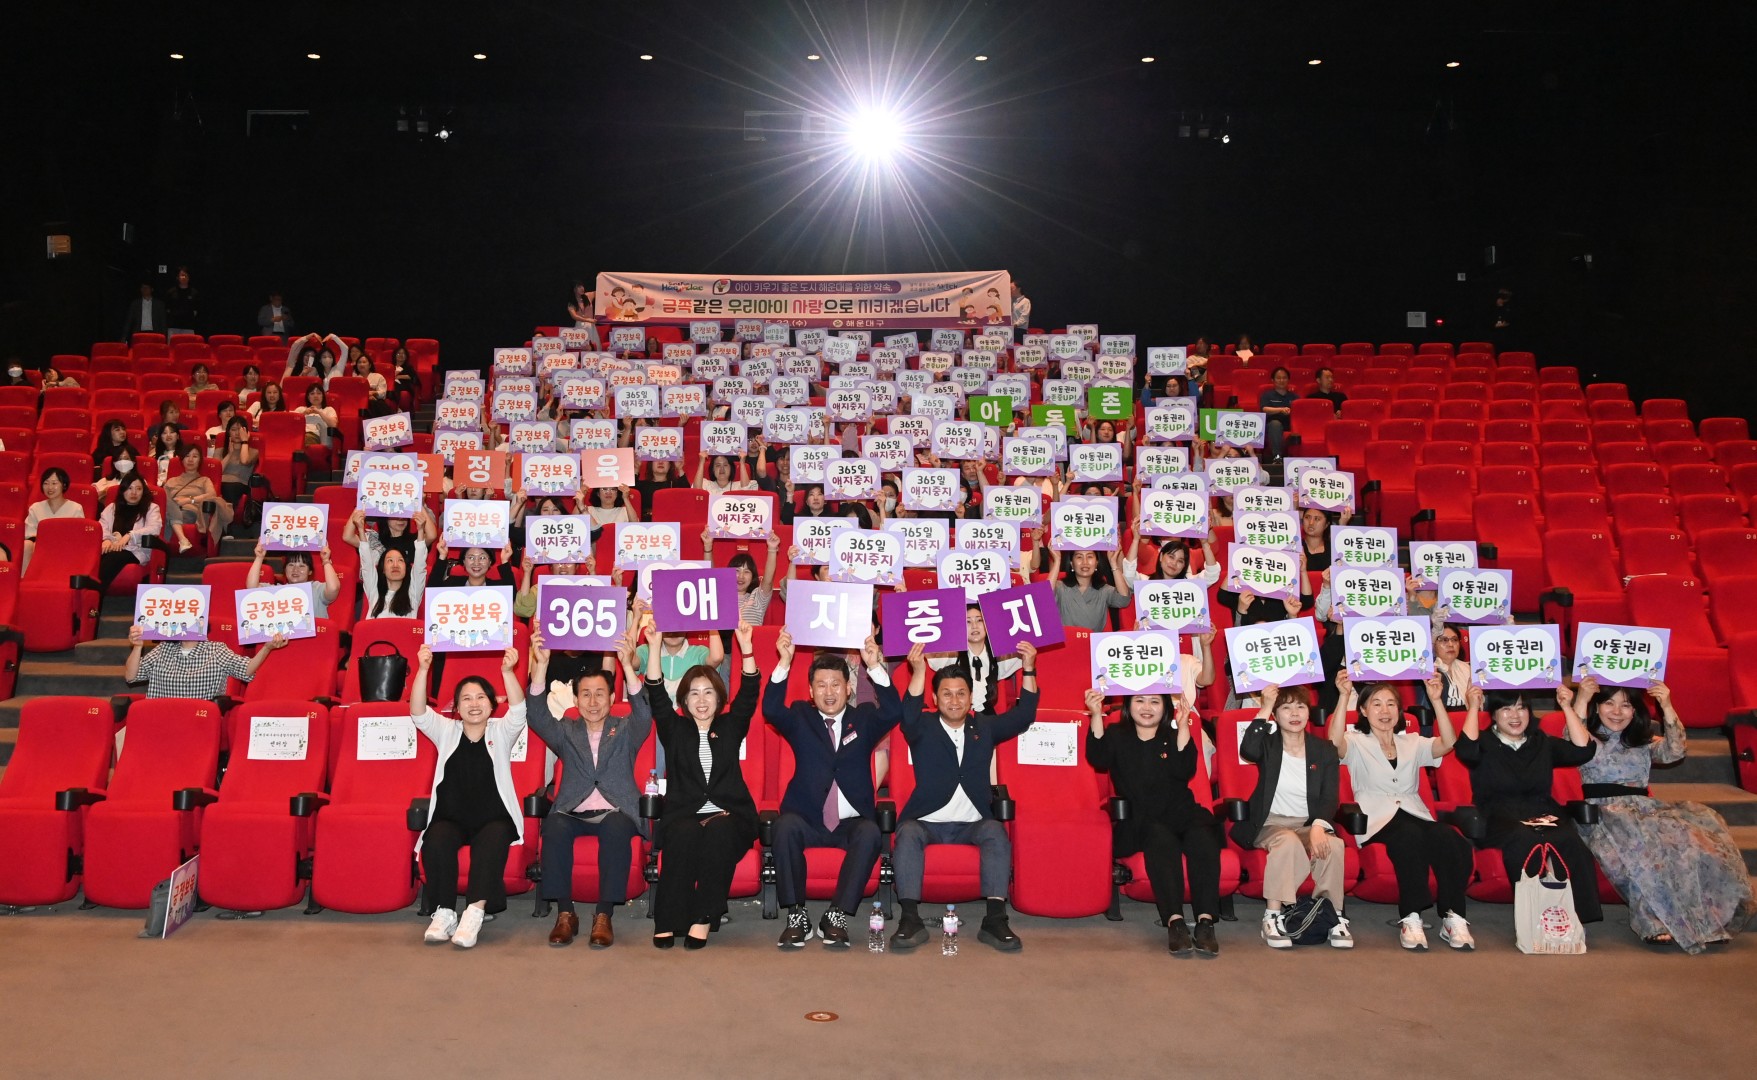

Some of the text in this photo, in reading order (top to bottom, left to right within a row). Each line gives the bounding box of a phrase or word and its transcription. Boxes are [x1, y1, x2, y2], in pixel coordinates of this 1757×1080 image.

[734, 282, 751, 292] 아이
[754, 282, 780, 292] 키우기
[782, 282, 798, 292] 좋은
[800, 282, 817, 292] 도시
[818, 282, 852, 292] 해운대를
[855, 282, 872, 292] 위한
[662, 298, 950, 314] 금쪽같은 우리아이 사랑으로 지키겠습니다
[738, 324, 761, 333] 긍정보육
[845, 319, 885, 327] 해운대구
[693, 326, 717, 335] 긍정보육
[803, 332, 821, 340] 365일
[940, 332, 956, 340] 365일
[1072, 328, 1094, 336] 아동권리
[562, 332, 586, 342] 긍정보육
[616, 332, 641, 342] 긍정보육
[892, 337, 910, 345] 365일
[1106, 340, 1129, 348] 아동권리
[666, 349, 692, 358] 긍정보육
[712, 347, 737, 356] 긍정보육
[1020, 350, 1042, 358] 아동권리
[1154, 353, 1180, 361] 아동권리
[498, 354, 528, 364] 긍정보육
[546, 358, 574, 368] 긍정보육
[701, 358, 720, 366] 365일
[792, 359, 812, 367] 365일
[1102, 360, 1127, 368] 아동권리
[748, 361, 767, 371] 365일
[1067, 366, 1090, 374] 아동권리
[612, 374, 644, 385] 긍정보육
[648, 370, 677, 379] 긍정보육
[905, 374, 924, 382] 365일
[956, 372, 981, 380] 아동권리
[723, 380, 743, 388] 365일
[779, 380, 799, 388] 365일
[1050, 385, 1077, 394] 아동권리
[450, 385, 480, 396] 긍정보육
[566, 384, 600, 396] 긍정보육
[626, 390, 648, 400] 365일
[667, 392, 701, 404] 긍정보육
[837, 394, 861, 402] 365일
[1101, 391, 1121, 415] 존
[498, 399, 532, 410] 긍정보육
[742, 400, 765, 408] 365일
[441, 407, 475, 417] 긍정보육
[980, 400, 1002, 422] 아
[775, 414, 798, 423] 365일
[1154, 413, 1185, 423] 아동권리
[370, 420, 406, 437] 긍정보육
[899, 420, 923, 429] 365일
[1226, 420, 1256, 428] 아동권리
[515, 430, 550, 442] 긍정보육
[576, 427, 612, 439] 긍정보육
[712, 426, 736, 435] 365일
[945, 427, 972, 437] 365일
[642, 435, 677, 447] 긍정보육
[874, 440, 900, 450] 365일
[1012, 445, 1046, 454] 아동권리
[803, 451, 829, 460] 365일
[1079, 452, 1112, 461] 아동권리
[1146, 454, 1179, 464] 아동권리
[468, 455, 490, 483] 정
[528, 464, 573, 478] 긍정보육
[596, 454, 620, 482] 육
[837, 464, 866, 475] 365일
[1215, 466, 1249, 475] 아동권리
[832, 476, 873, 486] 애지중지
[917, 475, 946, 485] 365일
[1309, 476, 1345, 489] 아동권리
[366, 481, 415, 498] 긍정보육
[910, 486, 952, 497] 애지중지
[994, 495, 1031, 505] 아동권리
[1244, 495, 1282, 506] 아동권리
[1309, 489, 1345, 502] 존중UP!
[724, 502, 757, 512] 365일
[1153, 499, 1196, 510] 아동권리
[994, 506, 1031, 517] 존중UP!
[270, 514, 320, 531] 긍정보육
[452, 511, 501, 528] 긍정보육
[717, 513, 763, 524] 애지중지
[1063, 513, 1106, 524] 아동권리
[1153, 513, 1196, 525] 존중UP!
[542, 523, 574, 535] 365일
[1246, 520, 1288, 532] 아동권리
[901, 527, 933, 538] 365일
[972, 528, 1004, 540] 365일
[1064, 527, 1106, 538] 존중UP!
[534, 535, 581, 547] 애지중지
[623, 534, 672, 550] 긍정보육
[1247, 532, 1289, 545] 존중UP!
[1343, 537, 1386, 549] 아동권리
[850, 538, 886, 552] 365일
[965, 540, 1011, 551] 애지중지
[840, 551, 893, 566] 애지중지
[1344, 550, 1386, 563] 존중UP!
[1423, 552, 1466, 564] 아동권리
[955, 558, 991, 571] 365일
[1242, 556, 1286, 572] 아동권리
[949, 571, 1000, 585] 애지중지
[1242, 570, 1287, 586] 존중UP!
[1344, 578, 1392, 591] 아동권리
[1452, 580, 1498, 594] 아동권리
[676, 577, 718, 621] 애
[1148, 591, 1195, 604] 아동권리
[1346, 593, 1393, 607] 존중UP!
[1452, 595, 1498, 609] 존중UP!
[144, 598, 200, 616] 긍정보육
[246, 597, 304, 620] 긍정보육
[436, 602, 502, 625] 긍정보육
[548, 598, 618, 638] 365
[810, 592, 848, 638] 지
[1002, 593, 1043, 638] 지
[1149, 606, 1196, 620] 존중UP!
[904, 598, 944, 644] 중
[1360, 630, 1415, 646] 아동권리
[1244, 634, 1301, 654] 아동권리
[1487, 640, 1544, 655] 아동권리
[1594, 638, 1651, 654] 아동권리
[1107, 644, 1163, 661] 아동권리
[1362, 648, 1417, 664] 존중UP!
[1248, 653, 1305, 673] 존중UP!
[1488, 657, 1544, 672] 존중UP!
[1592, 654, 1649, 672] 존중UP!
[1108, 663, 1164, 678] 존중UP!
[172, 874, 195, 906] 긍정보육
